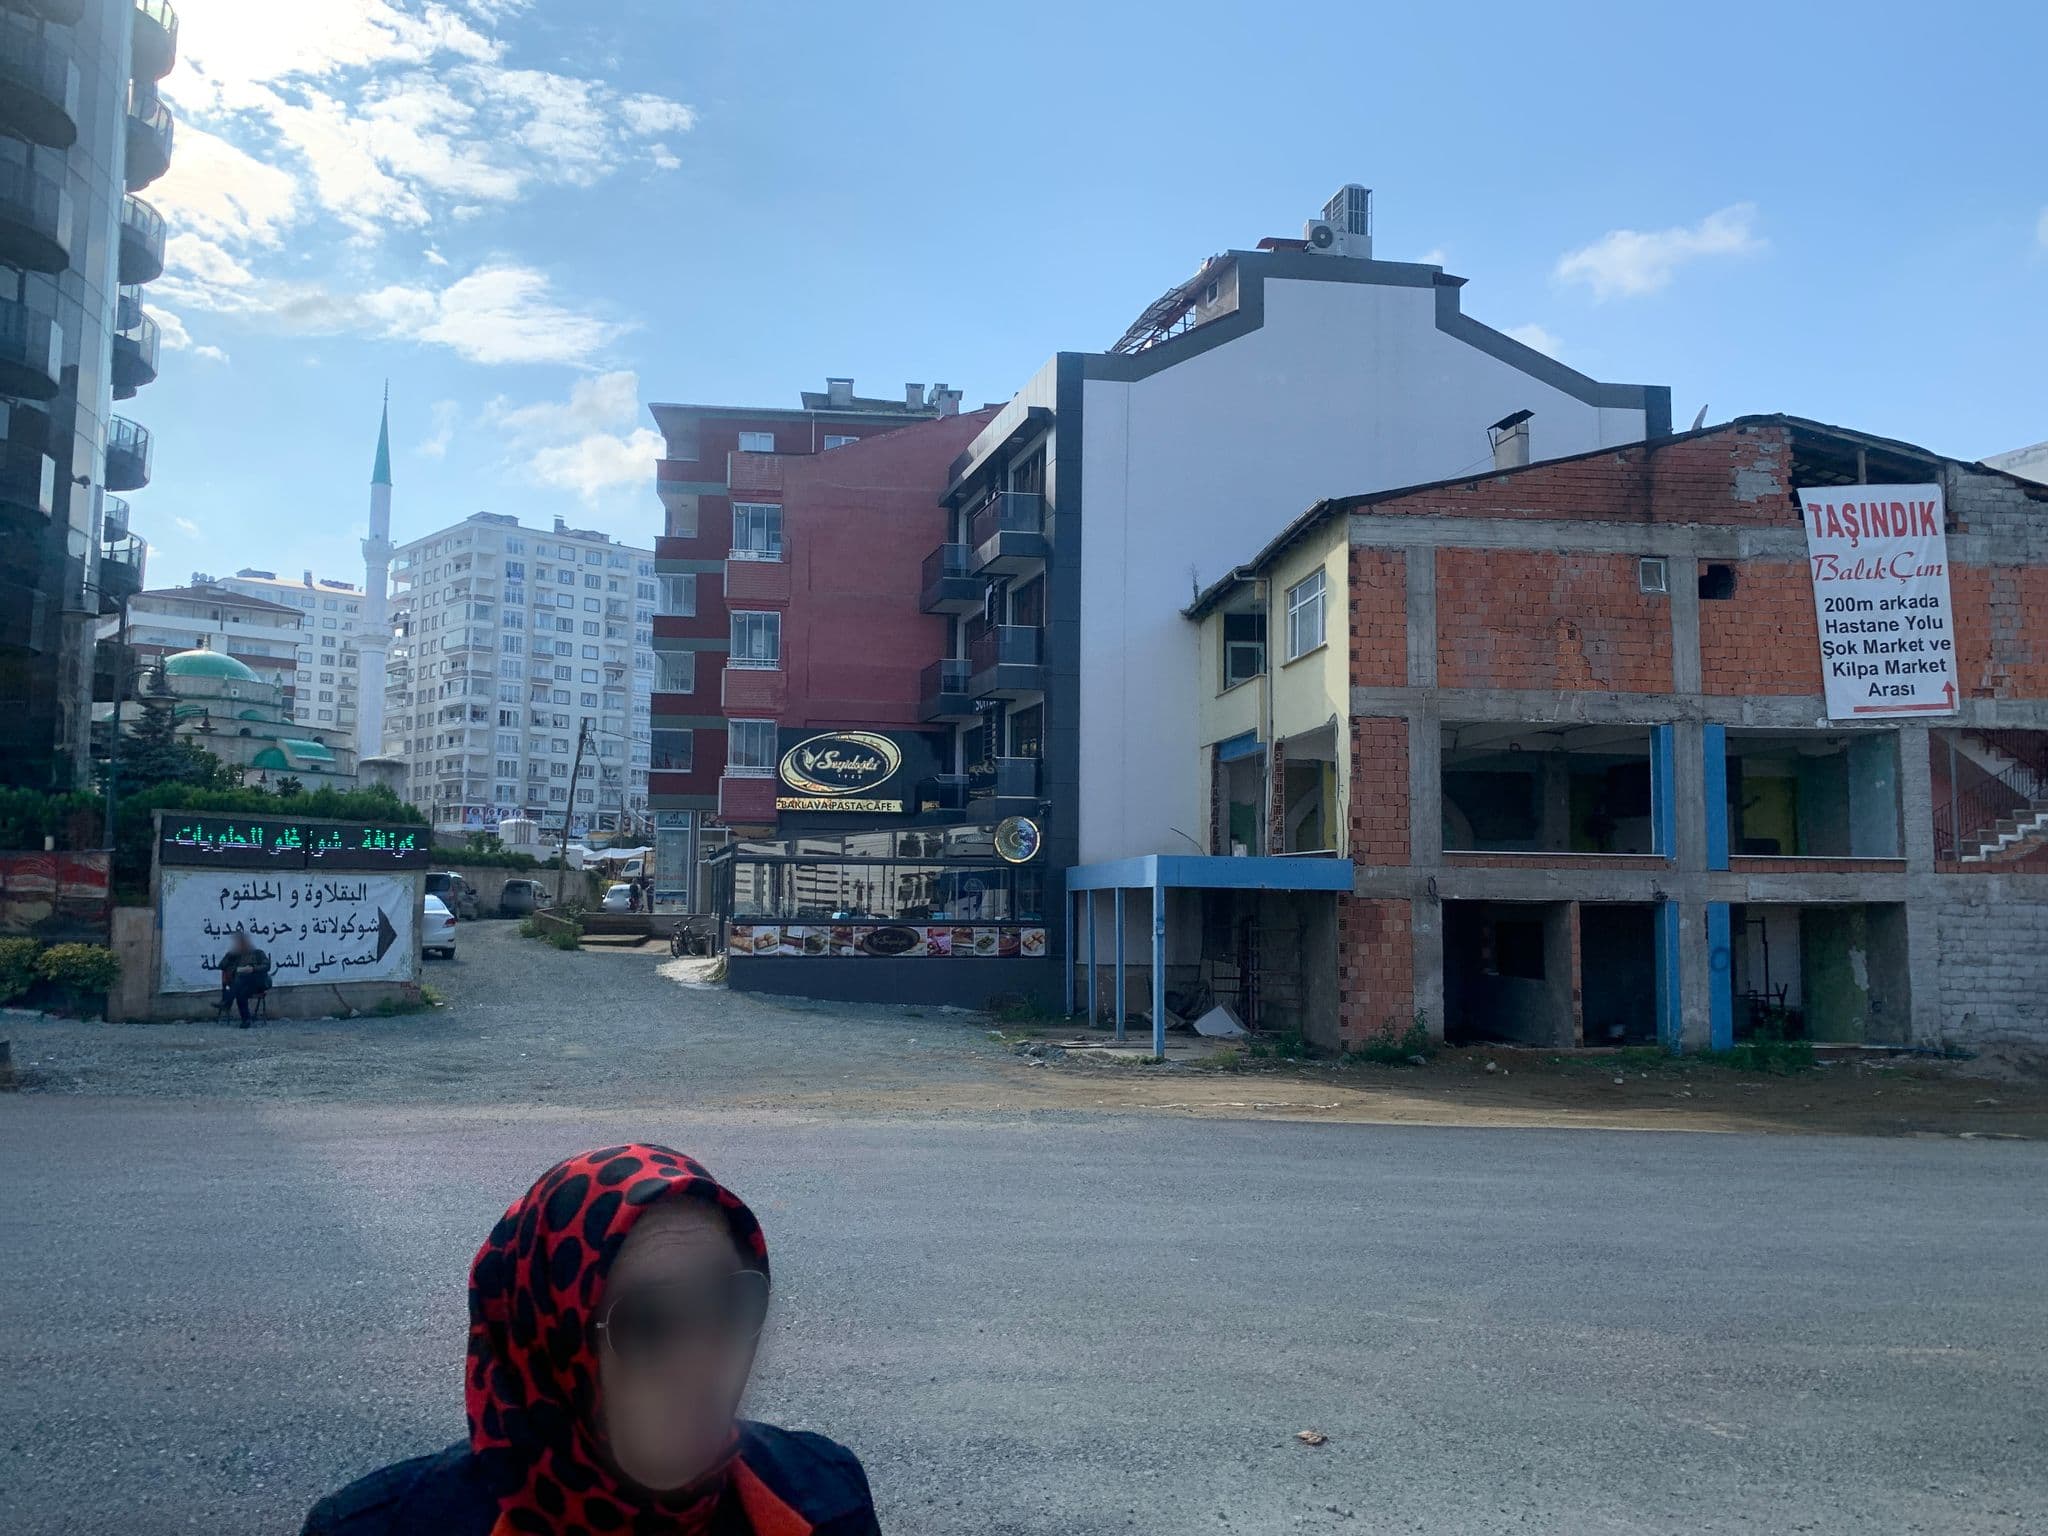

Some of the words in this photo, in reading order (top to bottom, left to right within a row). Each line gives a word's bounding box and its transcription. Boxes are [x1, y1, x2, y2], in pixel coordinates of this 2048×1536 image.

[1807, 501, 1939, 548] TAŞINDIK
[1824, 597, 1874, 613] 200m
[1880, 594, 1939, 611] arkada
[1825, 618, 1900, 634] Hastane
[1904, 615, 1944, 631] Yolu
[1822, 640, 1858, 660] Şok
[1863, 638, 1925, 654] Market
[1929, 639, 1952, 651] ve
[1832, 661, 1879, 680] Kilpa
[1885, 658, 1947, 675] Market
[1868, 682, 1916, 698] Arası
[219, 880, 282, 911] الحلقوم
[289, 890, 300, 909] و
[304, 882, 368, 909] البقلاوة
[250, 917, 292, 943] حزمة
[298, 923, 308, 941] و
[313, 912, 380, 941] شوكولاتة
[308, 952, 337, 975] على
